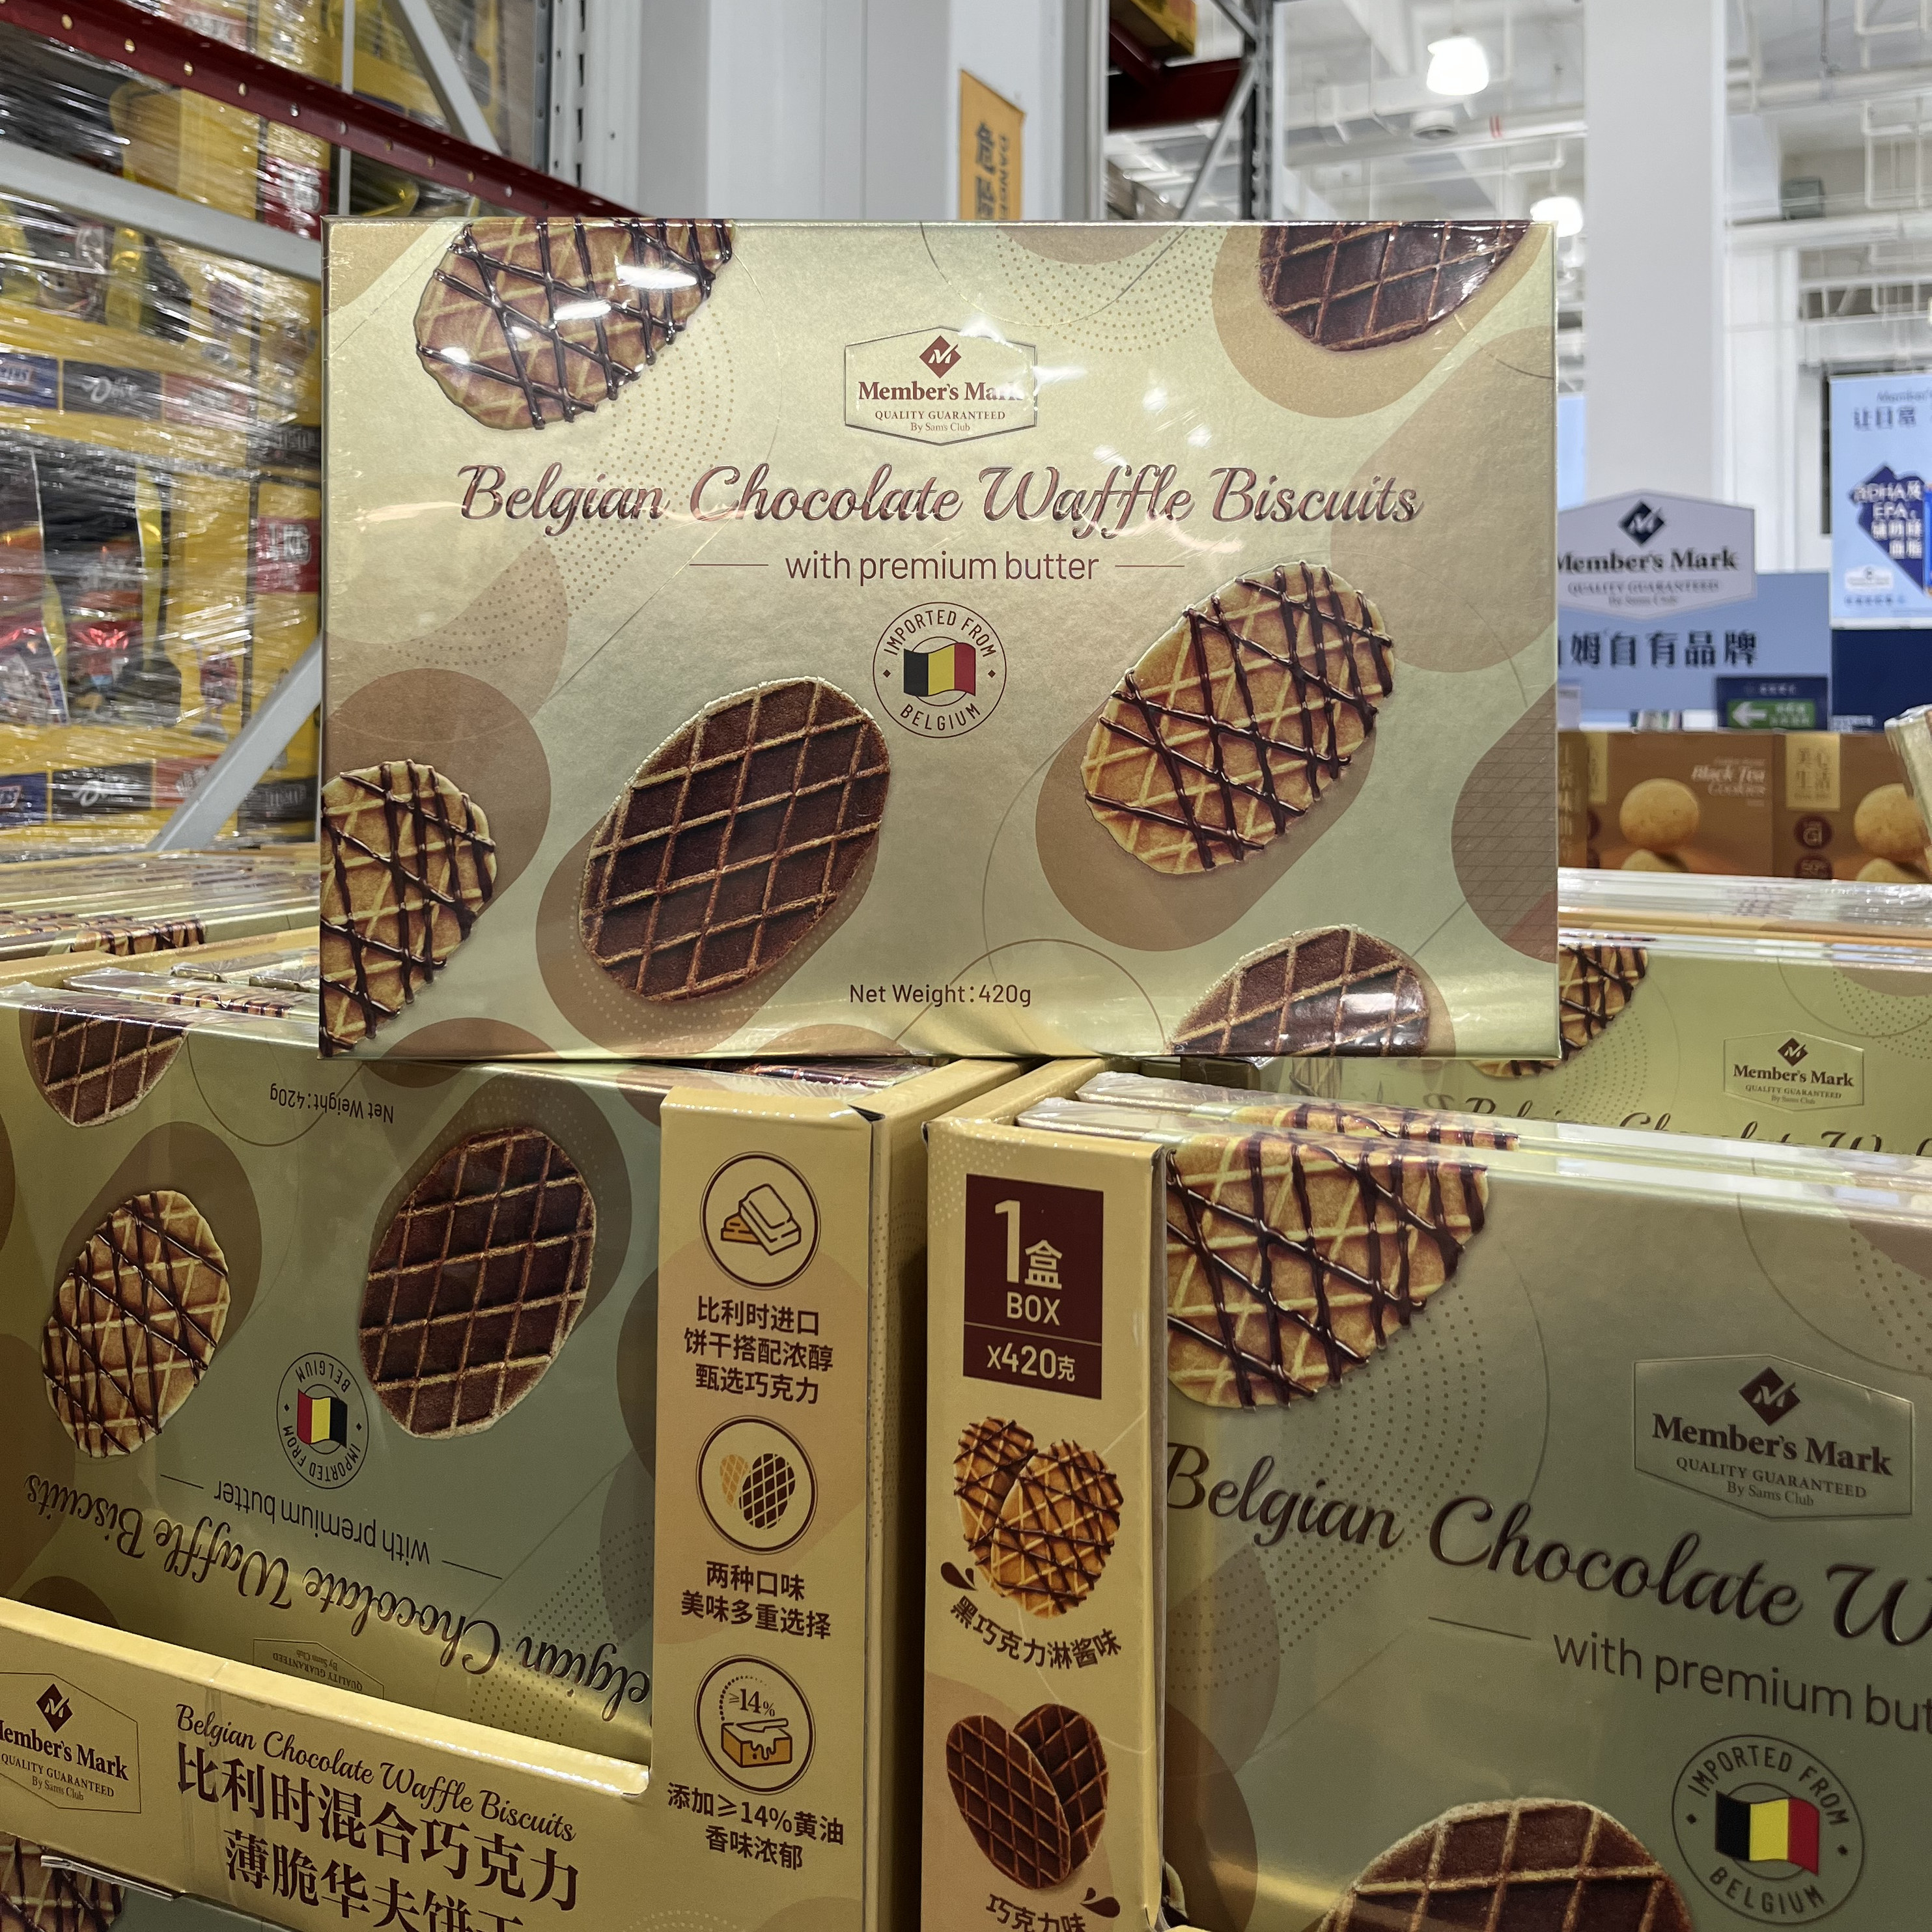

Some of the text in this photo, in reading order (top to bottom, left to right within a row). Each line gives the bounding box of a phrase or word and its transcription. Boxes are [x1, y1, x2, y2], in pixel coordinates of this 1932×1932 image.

[858, 381, 959, 400] Member's
[875, 410, 1005, 421] QUALITY GUARANTEED
[910, 422, 923, 432] By
[950, 422, 970, 432] Club
[457, 462, 1423, 539] Belgian Chocolate Waffle Biscuits
[785, 551, 1099, 586] with premium butter
[1671, 547, 1737, 572] Mark
[884, 609, 996, 658] IMPORTED FROM
[1558, 630, 1757, 667] 姆自有品牌
[901, 703, 980, 731] BELGIUM
[850, 985, 886, 1003] Net
[1733, 1064, 1855, 1087] Member's Mark
[368, 1102, 393, 1124] Net
[995, 1199, 1063, 1290] 1盒
[697, 1296, 819, 1336] 比利时进口
[1007, 1291, 1061, 1326] BOX
[684, 1327, 833, 1372] 饼干搭配浓醇
[295, 1360, 351, 1393] BELGIUM
[695, 1363, 819, 1405] 甄选巧克力
[283, 1425, 361, 1481] IMPORTED FROM
[1652, 1412, 1893, 1476] Member's Mark
[1677, 1457, 1867, 1498] QUALITY GUARANTEED
[1726, 1481, 1744, 1496] By
[1785, 1491, 1813, 1506] Club
[214, 1481, 430, 1566] with premium butter
[1167, 1442, 1404, 1548] Belgian
[1429, 1495, 1804, 1627] Chocolate
[23, 1474, 650, 1722] elgian Chocolate Waffle Biscuits
[706, 1561, 805, 1601] 两种口味
[680, 1589, 832, 1640] 美味多重选择
[950, 1595, 1122, 1670] 黑巧克力淋酱味
[273, 1653, 363, 1691] QUALITY GUARANTEED
[1553, 1632, 1642, 1679] with
[1655, 1655, 1852, 1720] premium
[729, 1688, 776, 1717] ≥14%
[0, 1720, 129, 1781] ember's Mark
[1, 1753, 114, 1798] QUALITY GUARANTEED
[33, 1776, 42, 1789] By
[66, 1787, 84, 1800] Club
[175, 1703, 578, 1842] Belgian Chocolate Waffle Biscuits
[1688, 1745, 1850, 1825] IMPORTED FROM
[177, 1741, 580, 1911] 比利时混合巧克力
[705, 1825, 803, 1870] 香味浓郁
[1709, 1866, 1825, 1914] BELGIUM
[986, 1894, 1085, 1932] 巧克力味
